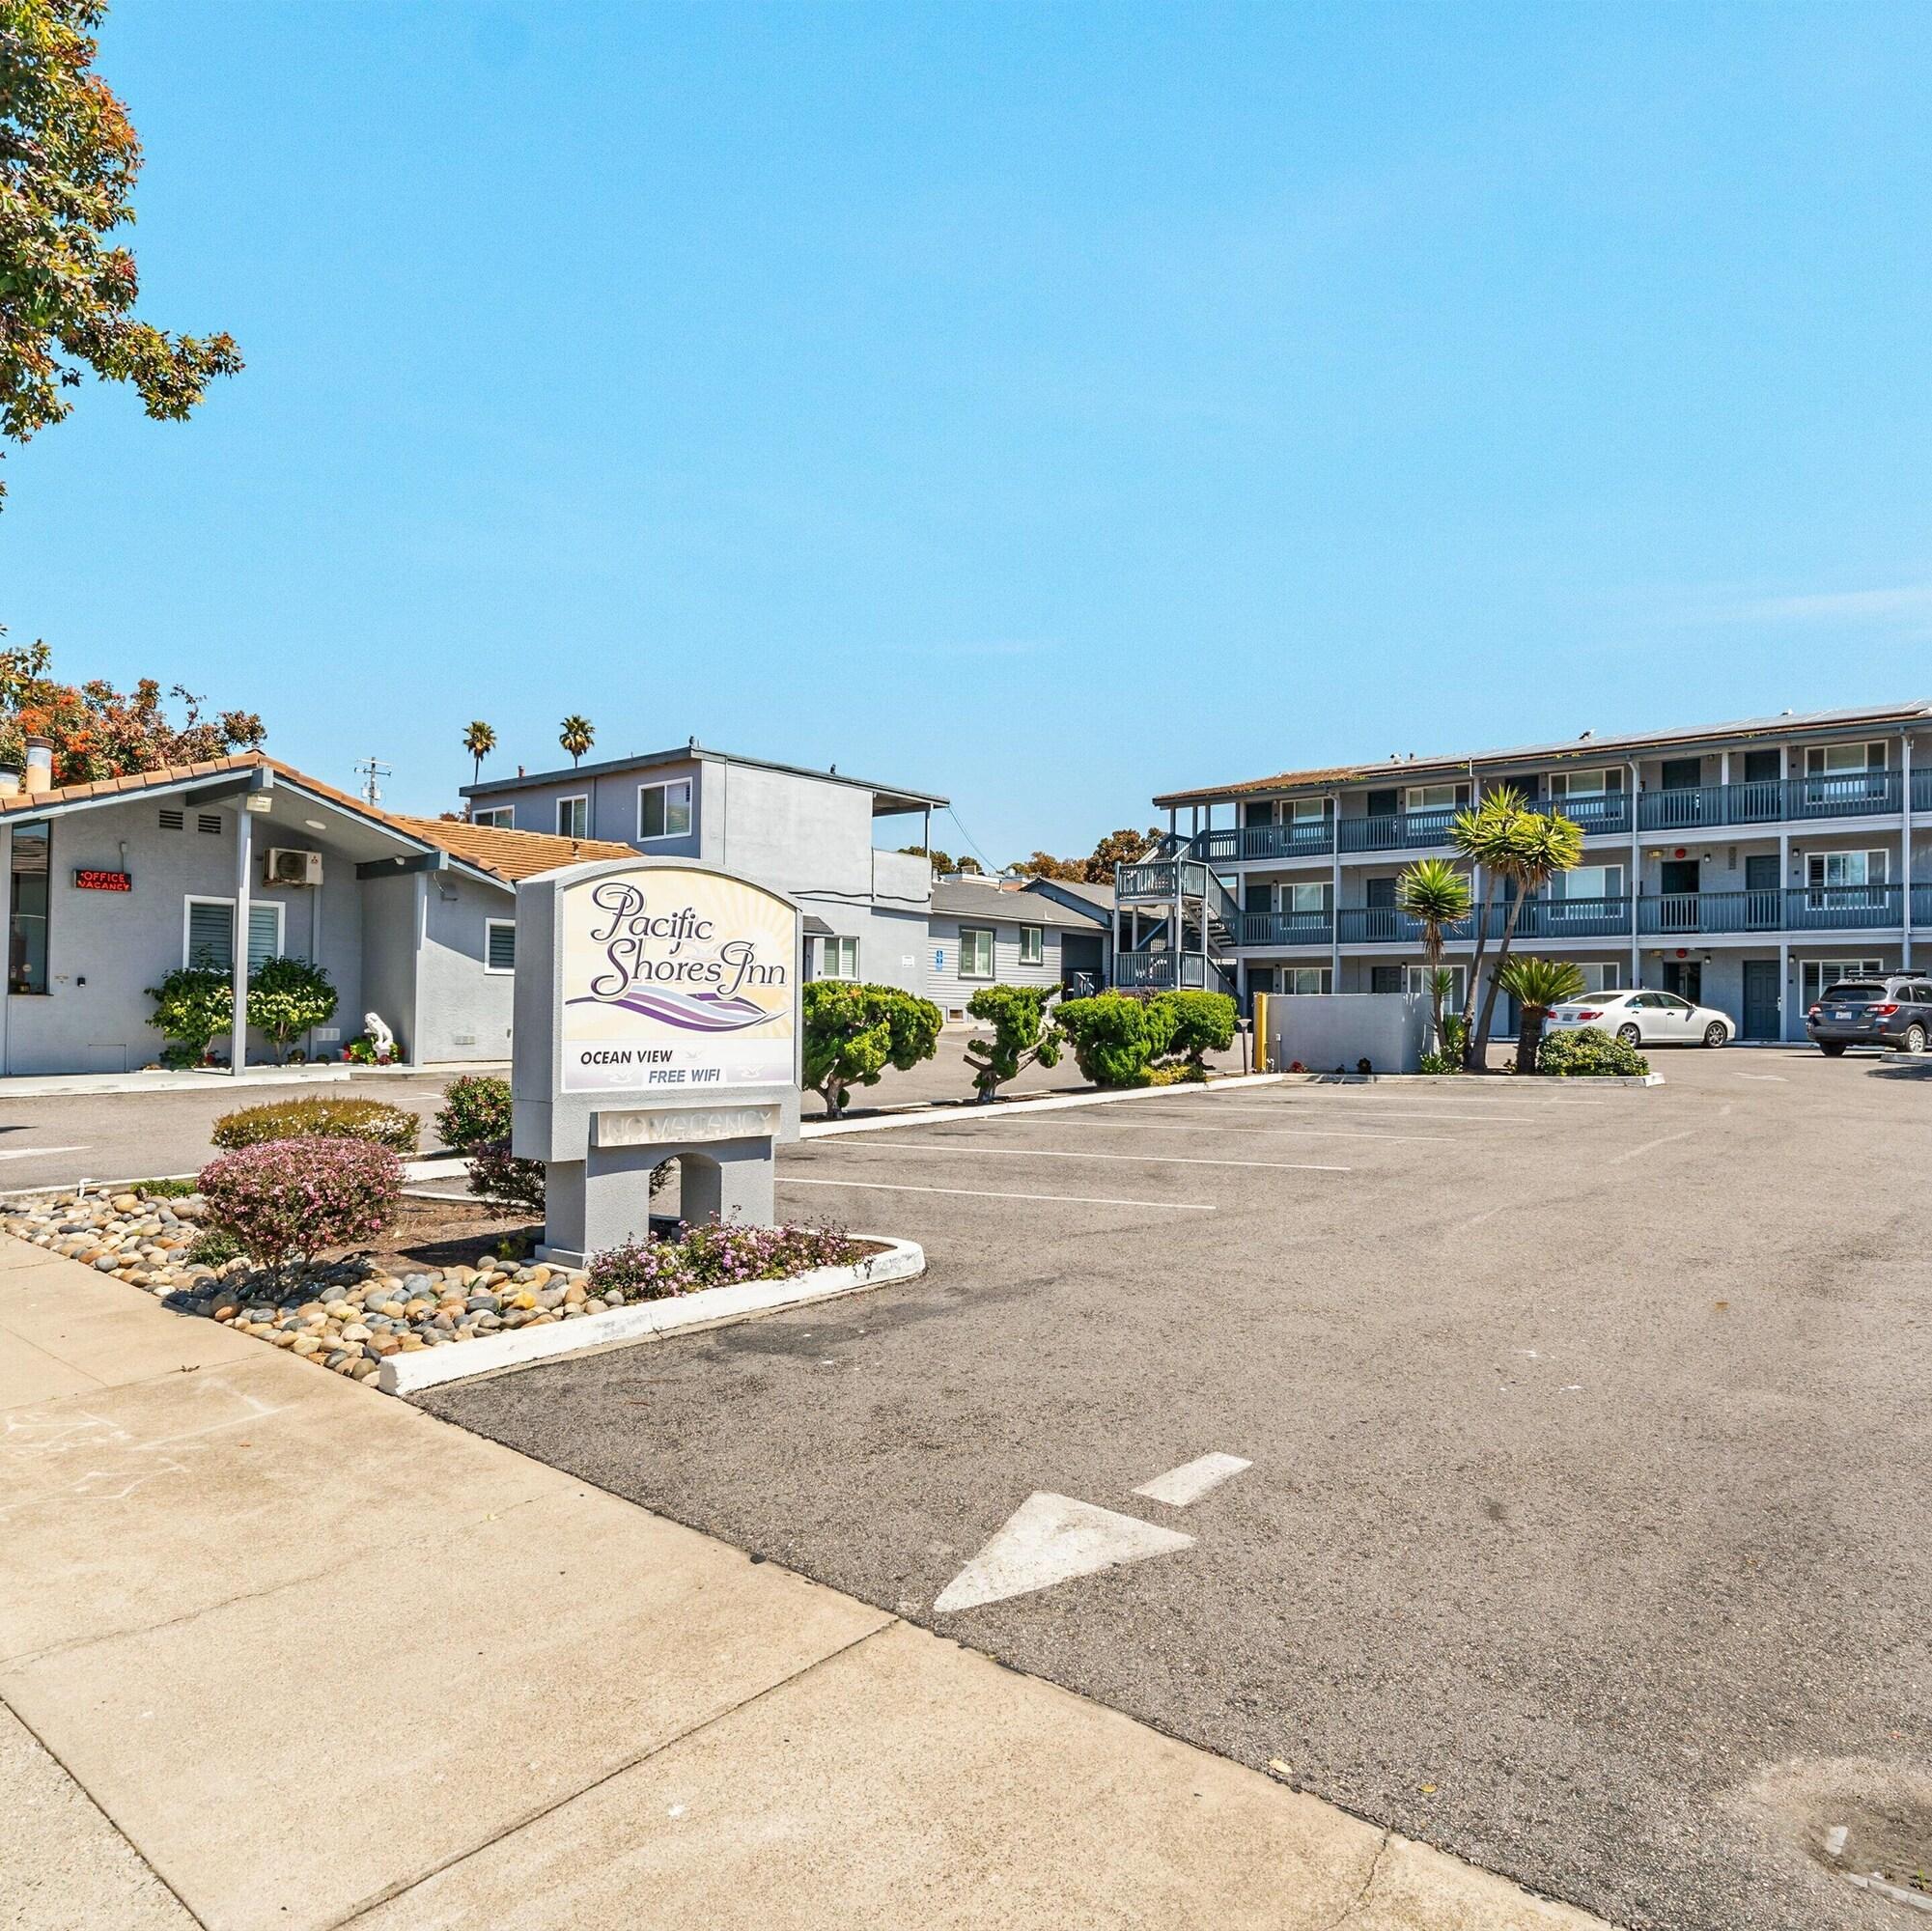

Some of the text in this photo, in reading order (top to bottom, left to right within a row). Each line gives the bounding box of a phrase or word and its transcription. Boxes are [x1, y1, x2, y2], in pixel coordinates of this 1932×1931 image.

[77, 880, 129, 890] VACANCY
[83, 871, 126, 883] OFFICE
[590, 882, 714, 955] Pacific
[590, 938, 786, 996] Shores Inn
[580, 1049, 674, 1065] OCEAN VIEW
[648, 1068, 721, 1083] FREE WIFI
[605, 1110, 772, 1138] NO VACANCY
